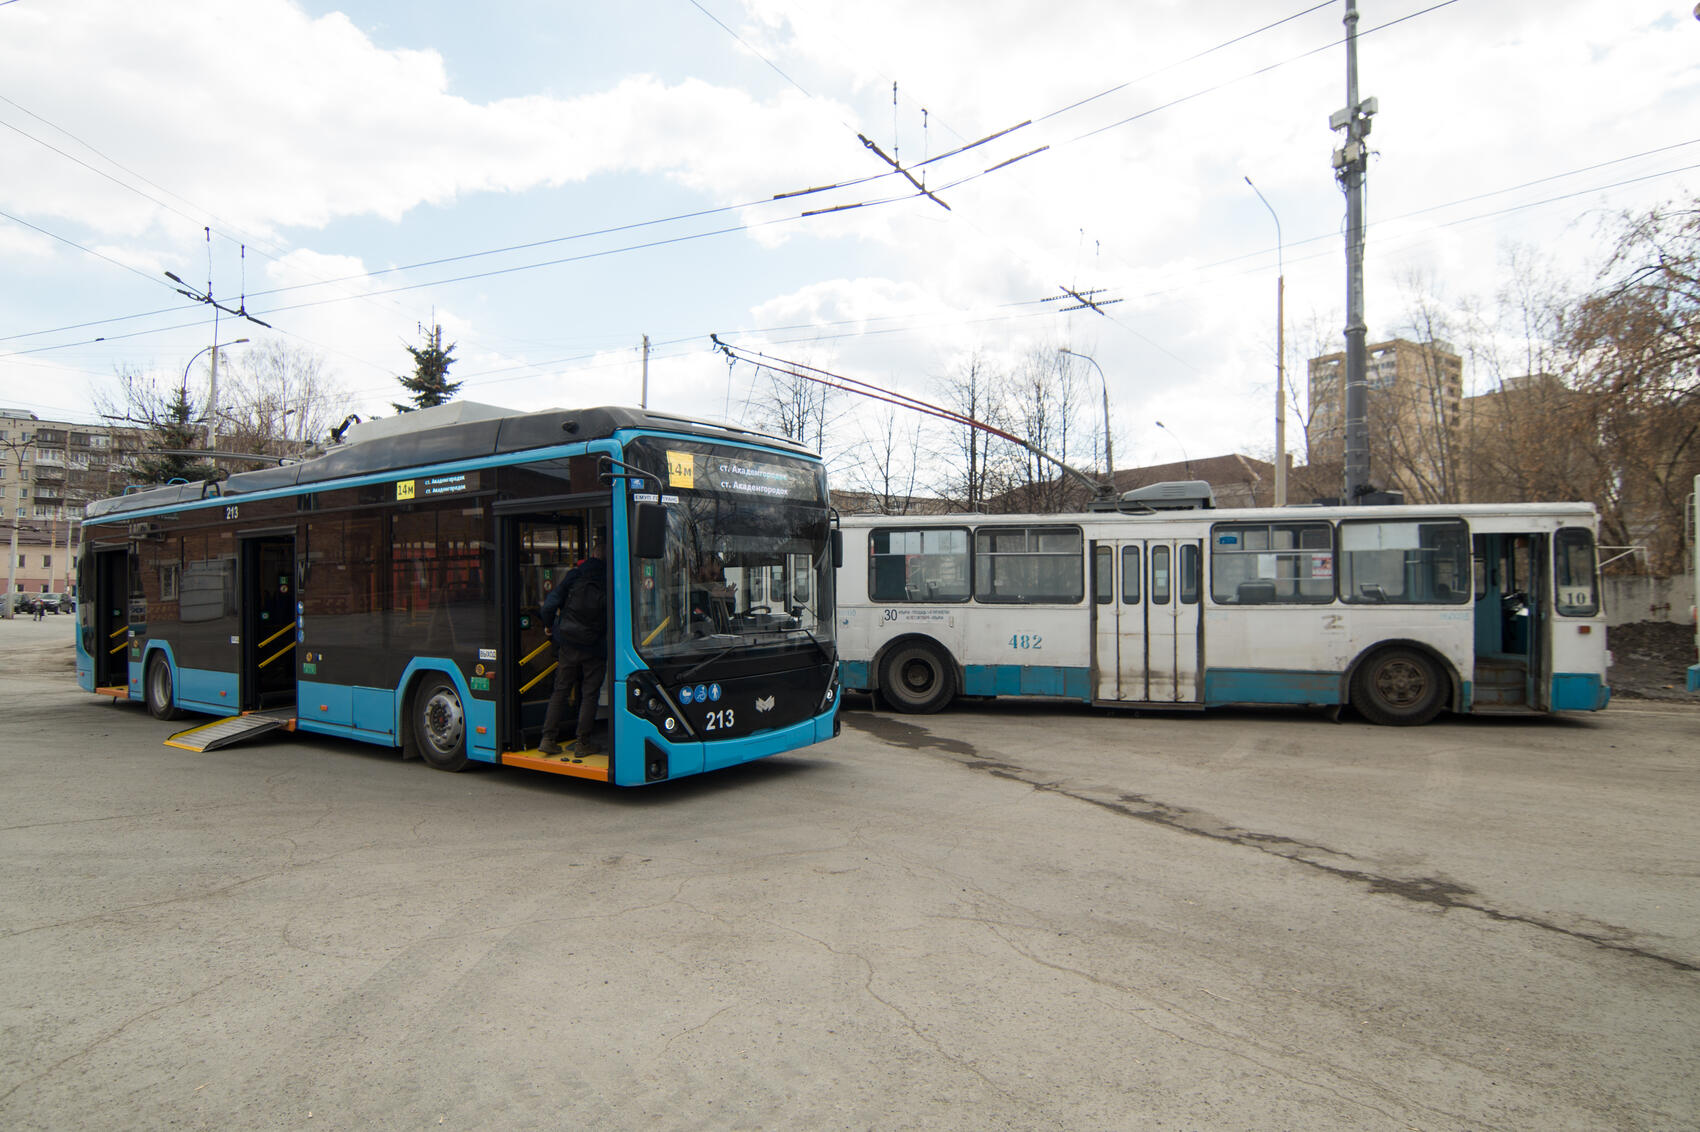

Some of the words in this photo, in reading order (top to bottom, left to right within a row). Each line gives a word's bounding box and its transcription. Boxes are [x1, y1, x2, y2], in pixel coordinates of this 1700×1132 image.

[226, 505, 239, 520] 213
[884, 609, 898, 621] 30
[1008, 634, 1043, 649] 482
[706, 709, 735, 731] 213
